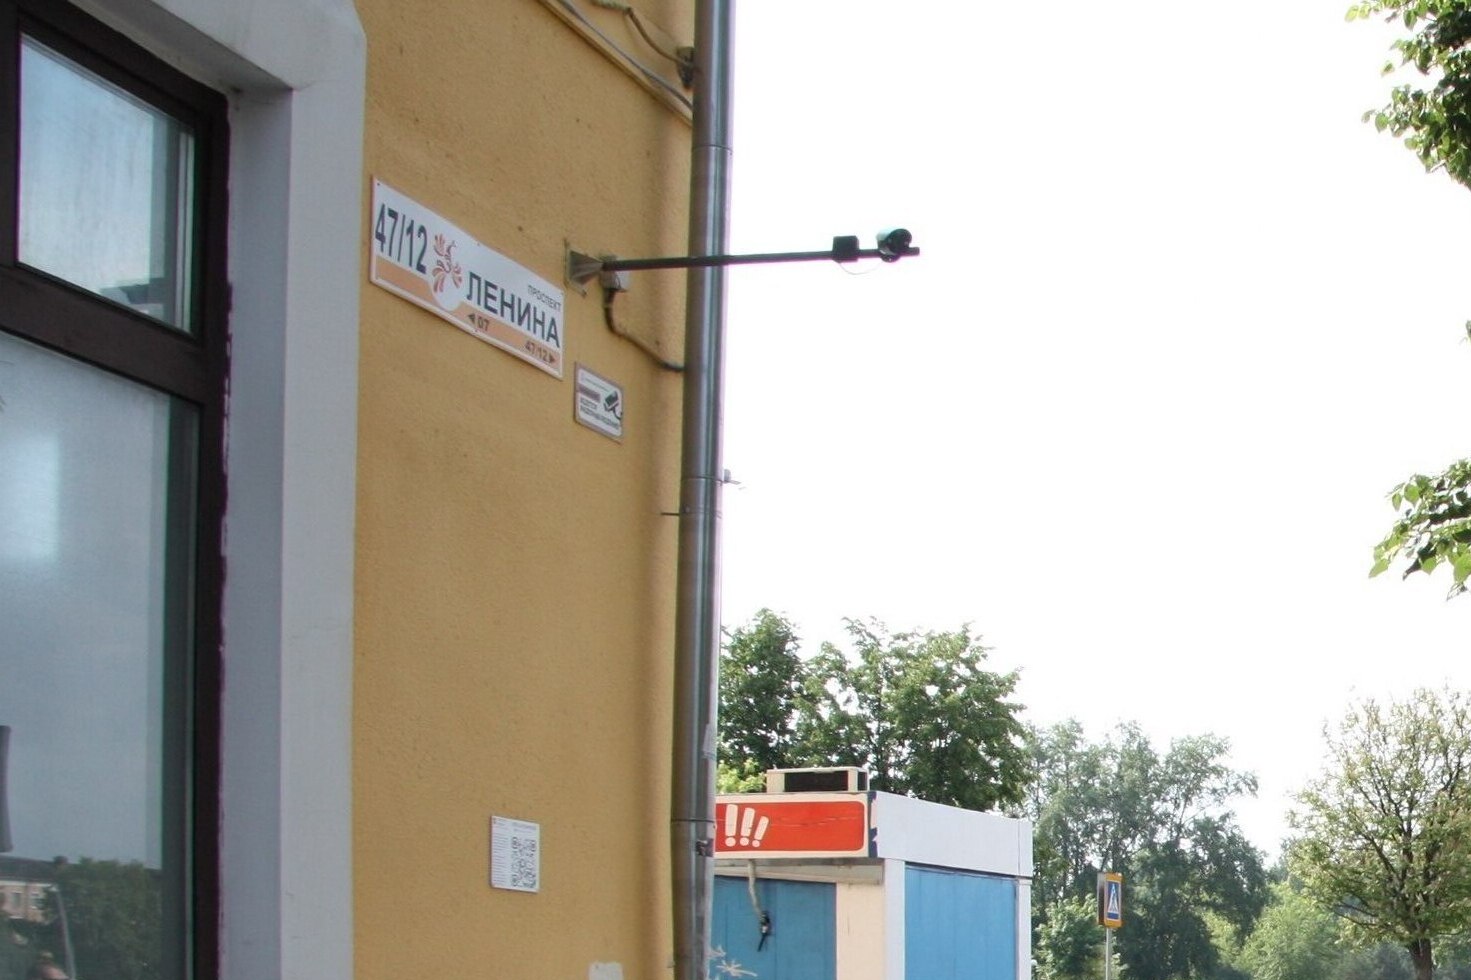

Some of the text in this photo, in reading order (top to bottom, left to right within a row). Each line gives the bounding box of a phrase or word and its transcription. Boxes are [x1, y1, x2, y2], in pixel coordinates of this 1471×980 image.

[375, 203, 428, 275] 47/12
[466, 271, 561, 348] ЛЕНИНА
[527, 285, 562, 311] ПРОСПЕКТ
